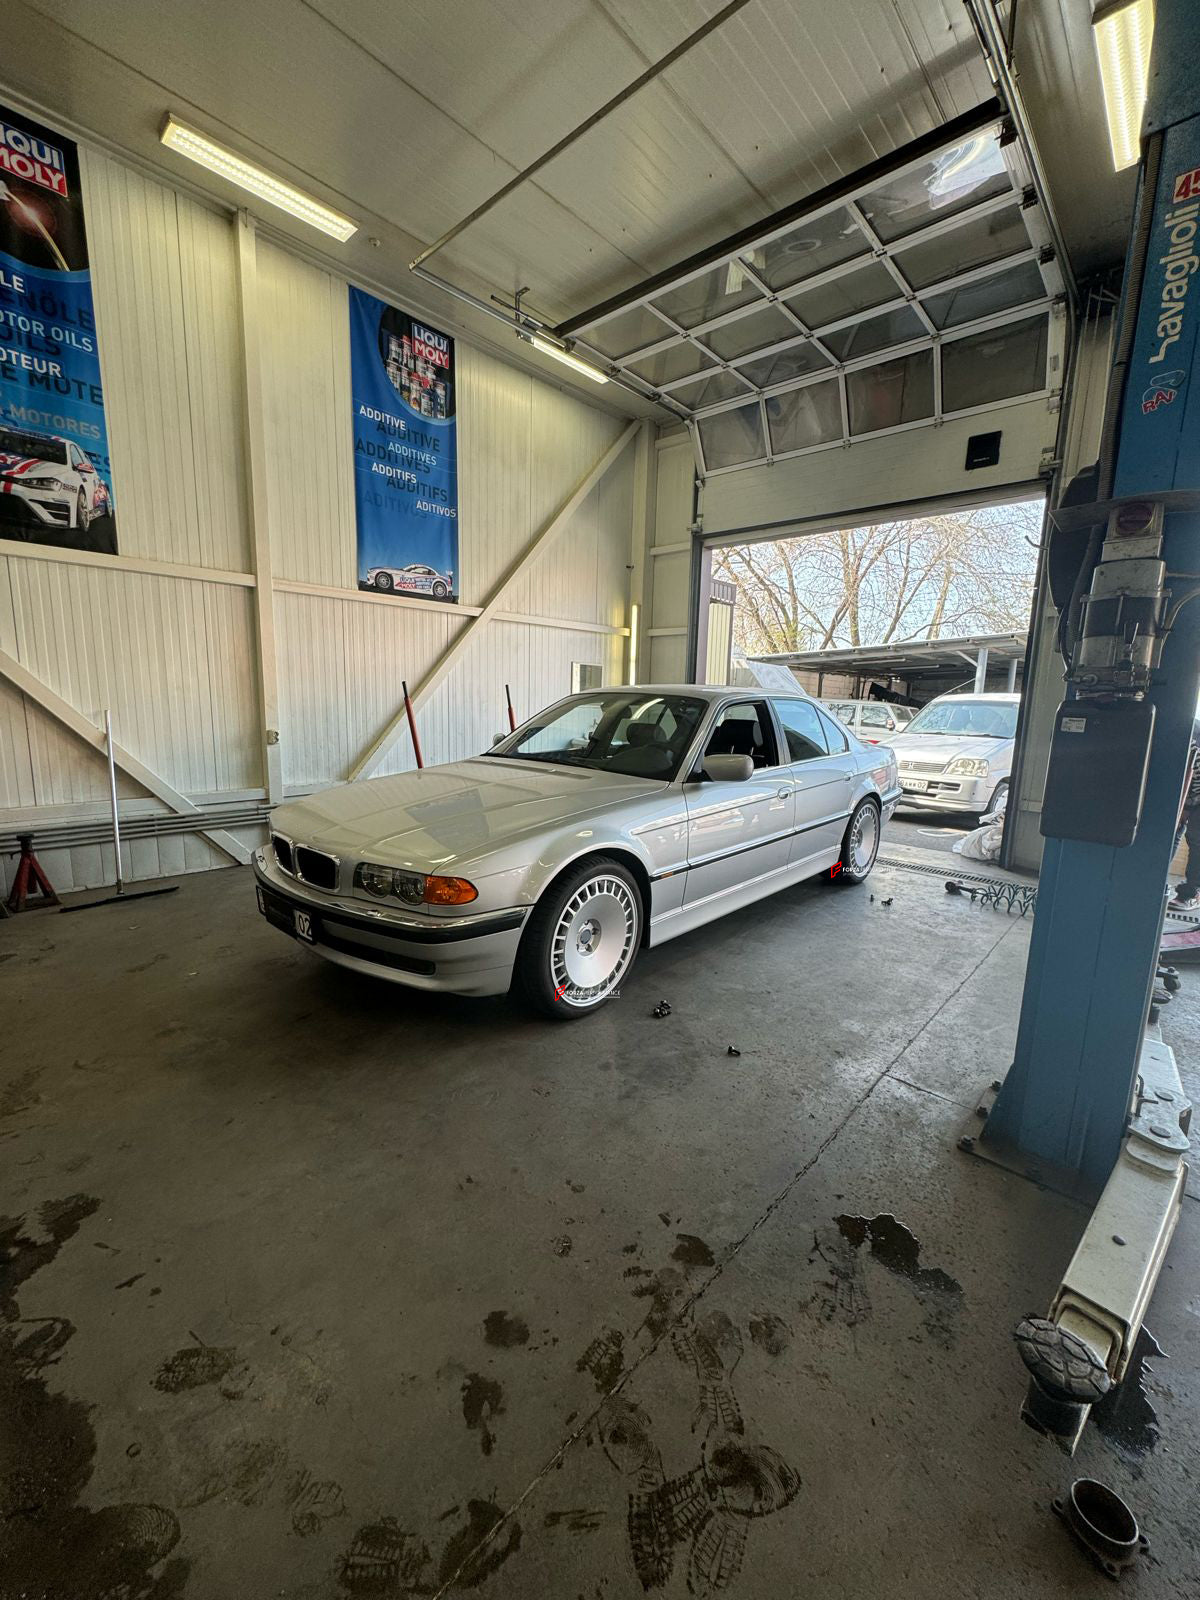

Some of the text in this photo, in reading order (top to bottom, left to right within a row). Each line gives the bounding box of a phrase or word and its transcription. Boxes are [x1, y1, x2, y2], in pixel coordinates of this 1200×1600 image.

[51, 326, 93, 352] OILS
[415, 325, 448, 352] LIQUI
[414, 342, 449, 367] MOLY
[10, 402, 101, 439] MOTORES
[360, 405, 406, 431] ADDITIVE
[388, 441, 437, 466] ADDITIVES
[372, 462, 417, 484] ADDITIFS
[416, 500, 456, 518] ADITIVOS
